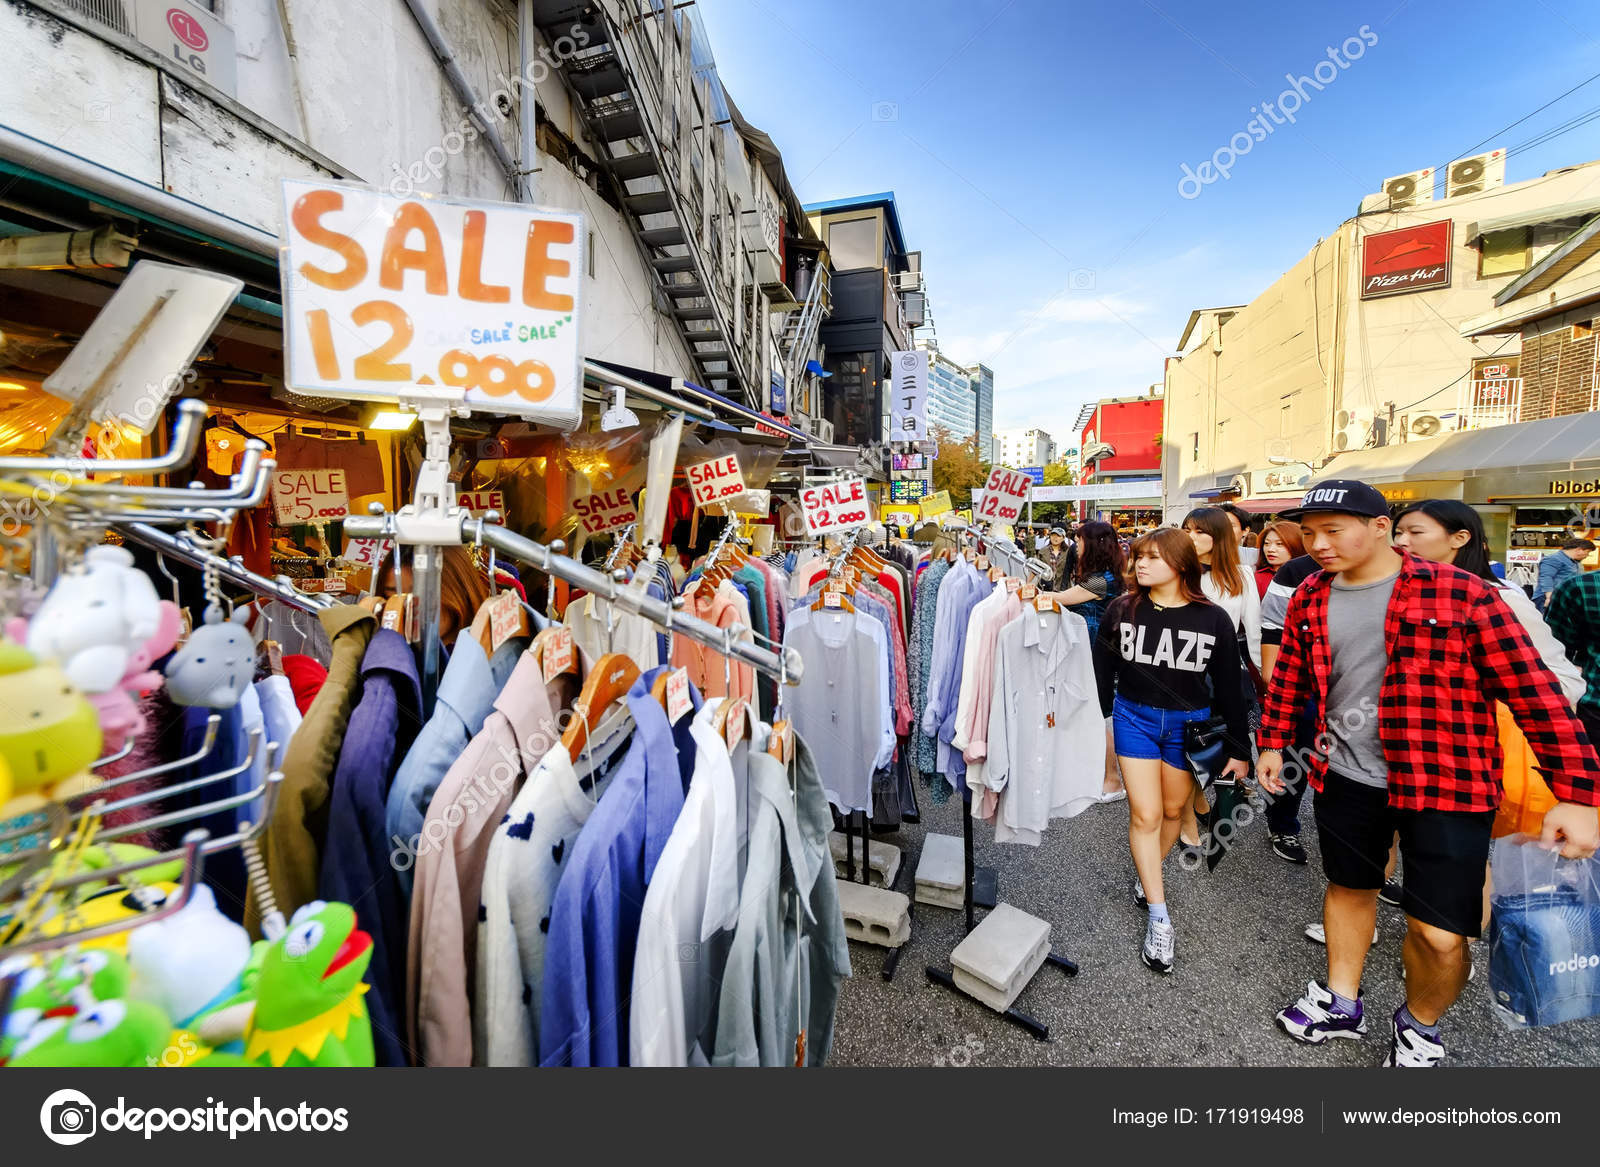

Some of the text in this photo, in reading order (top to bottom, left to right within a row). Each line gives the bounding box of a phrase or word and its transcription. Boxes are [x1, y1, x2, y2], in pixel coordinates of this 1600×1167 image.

[173, 43, 207, 76] LG
[291, 189, 575, 312] SALE
[1366, 266, 1445, 290] Pizza Hut
[470, 325, 512, 345] SALE
[518, 323, 558, 341] SALE
[305, 300, 556, 403] 12.000
[902, 375, 917, 432] 三丁目
[689, 457, 738, 486] SALE
[989, 470, 1032, 499] SALE
[279, 474, 344, 496] SALE
[697, 483, 743, 503] 12.000
[803, 481, 865, 510] SALE
[1313, 488, 1348, 503] OUT
[459, 492, 503, 511] ALE
[573, 487, 632, 518] SALE
[582, 511, 636, 534] 12.000
[809, 510, 866, 532] 12.000
[1119, 621, 1217, 673] BLAZE
[1549, 954, 1600, 975] rodeo
